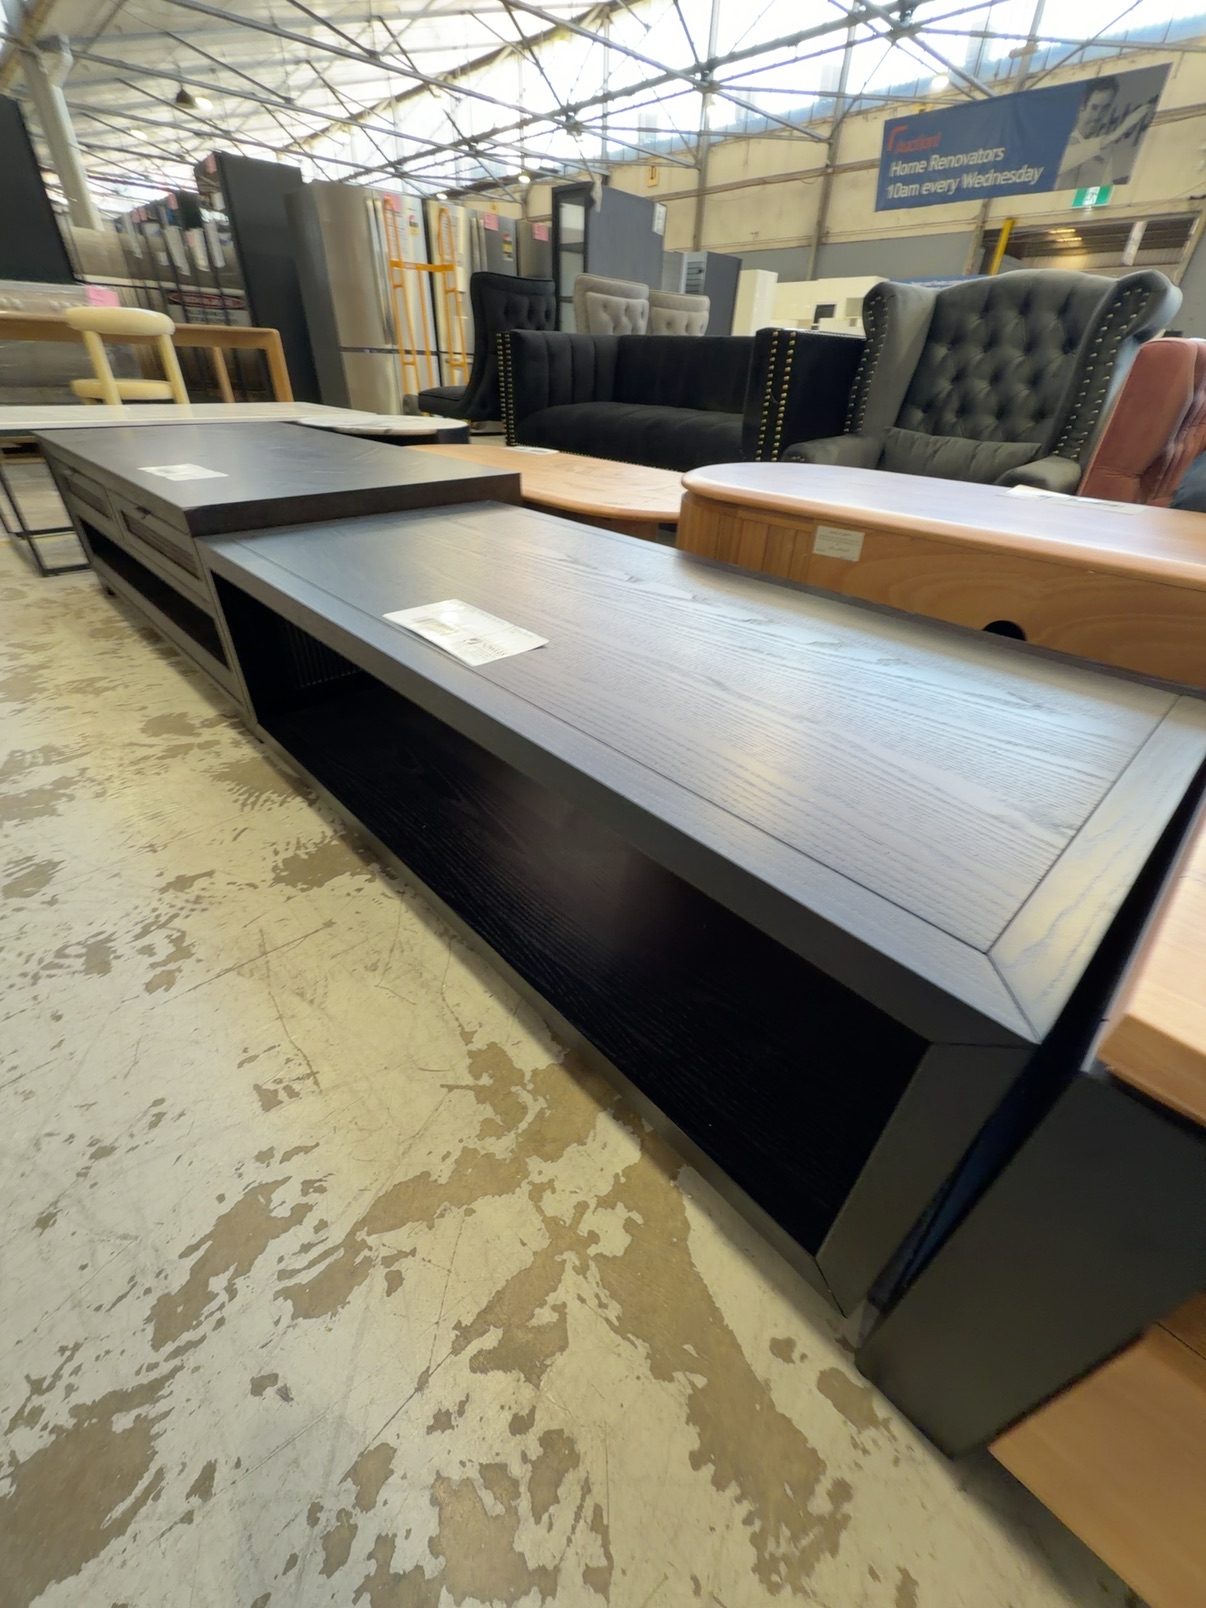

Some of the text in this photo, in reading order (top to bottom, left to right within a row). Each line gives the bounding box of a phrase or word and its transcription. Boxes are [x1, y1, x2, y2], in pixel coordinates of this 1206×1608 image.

[889, 147, 1005, 177] Home Renovators
[886, 165, 1045, 199] 10am every Wednesday
